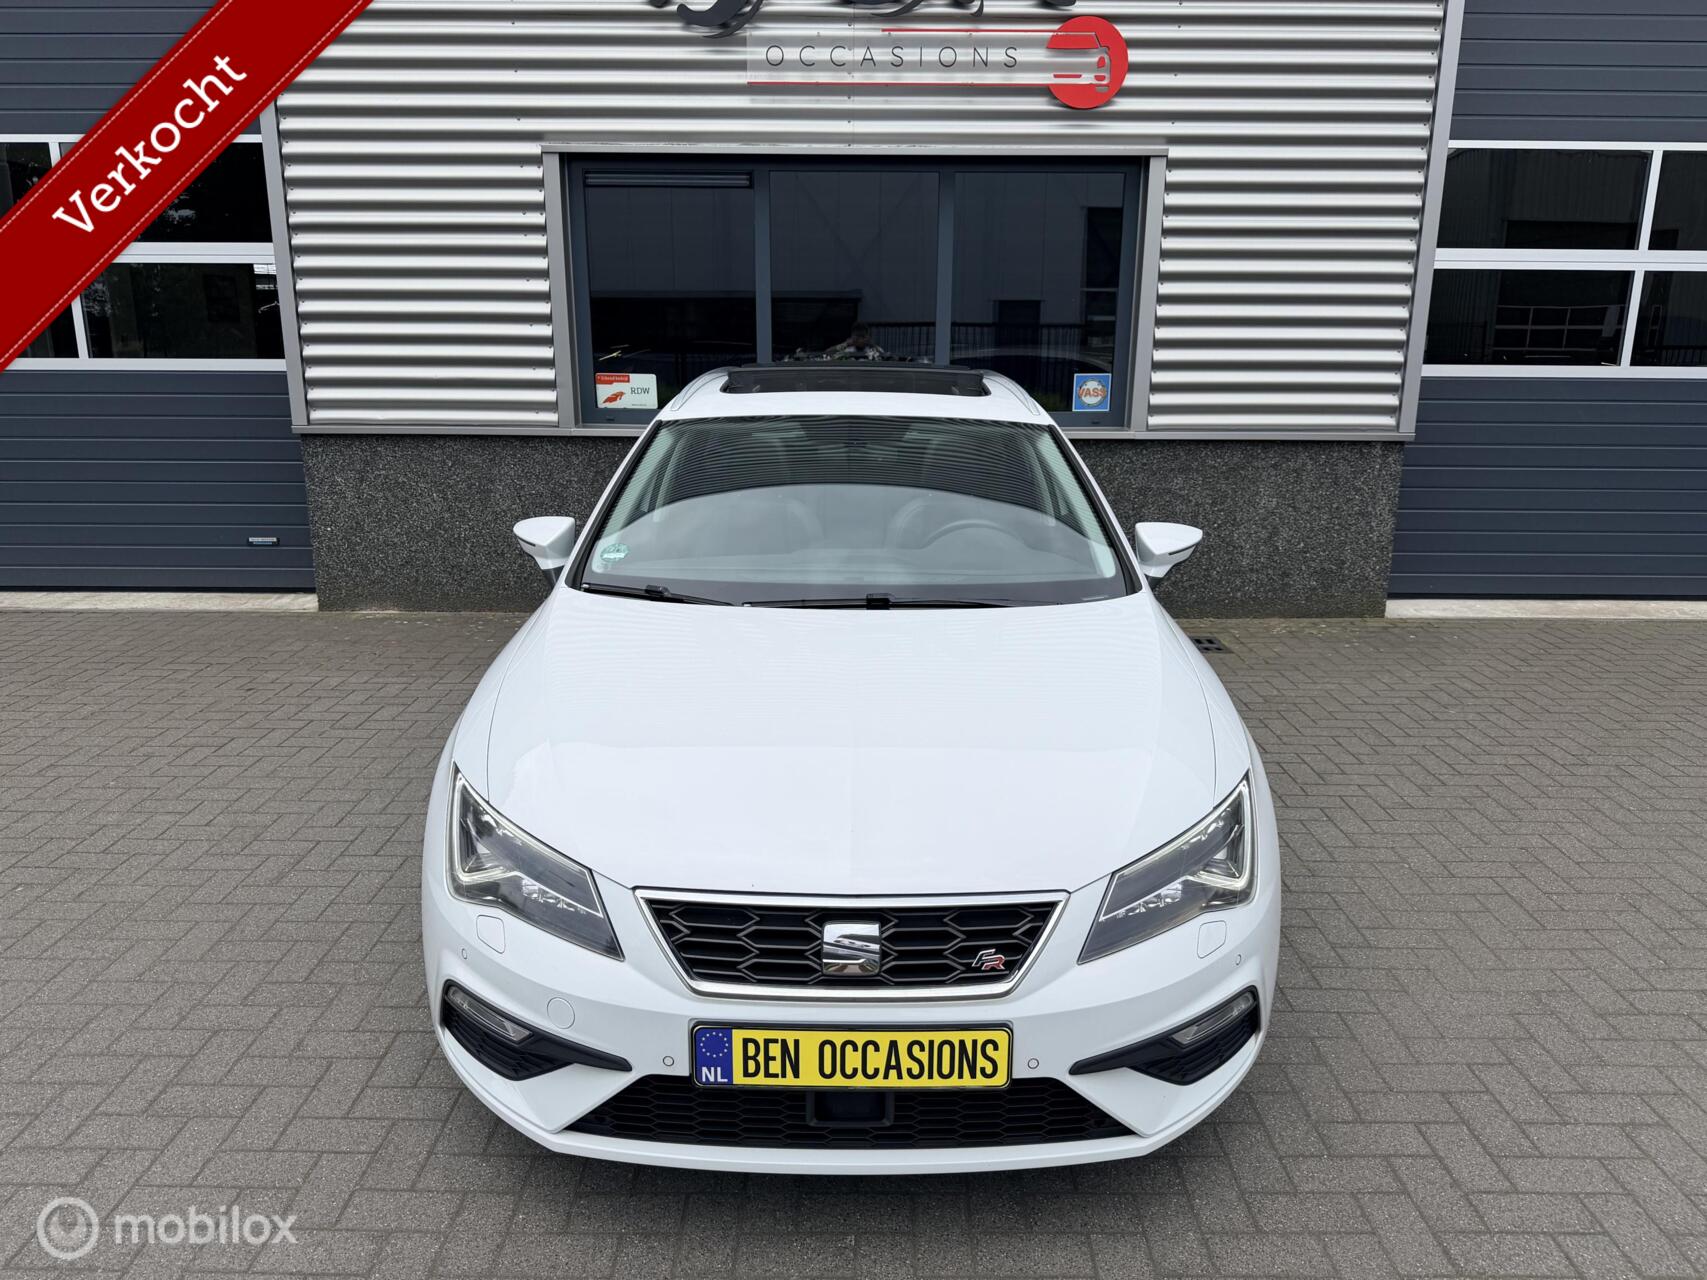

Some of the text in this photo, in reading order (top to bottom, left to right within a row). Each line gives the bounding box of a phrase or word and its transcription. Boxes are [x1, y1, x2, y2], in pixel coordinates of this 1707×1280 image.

[765, 45, 1018, 68] OCCASIONS
[630, 386, 650, 395] RDW
[972, 948, 1005, 970] FR
[742, 1038, 999, 1080] BEN OCCASIONS
[701, 1066, 728, 1082] NL
